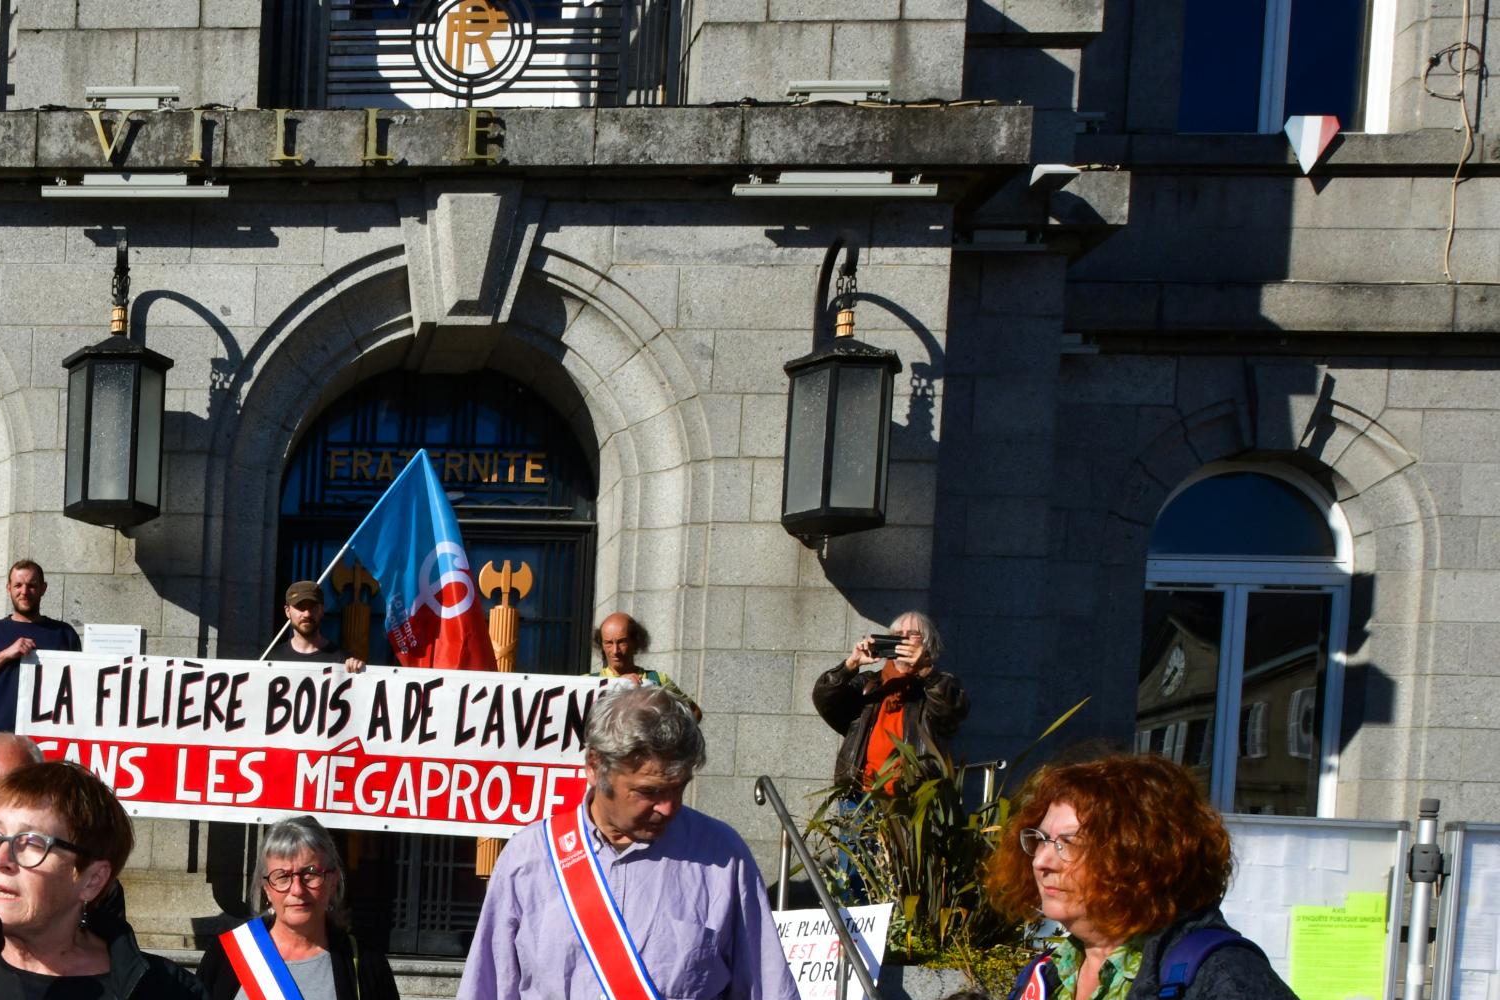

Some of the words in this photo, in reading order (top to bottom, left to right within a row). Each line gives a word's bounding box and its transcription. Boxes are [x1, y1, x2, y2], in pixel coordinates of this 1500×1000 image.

[84, 108, 500, 162] VILLE
[31, 665, 74, 725] LA
[367, 680, 392, 742] A
[401, 677, 443, 744] DE
[175, 748, 266, 803] LES
[293, 741, 587, 823] MÉGAPROJE
